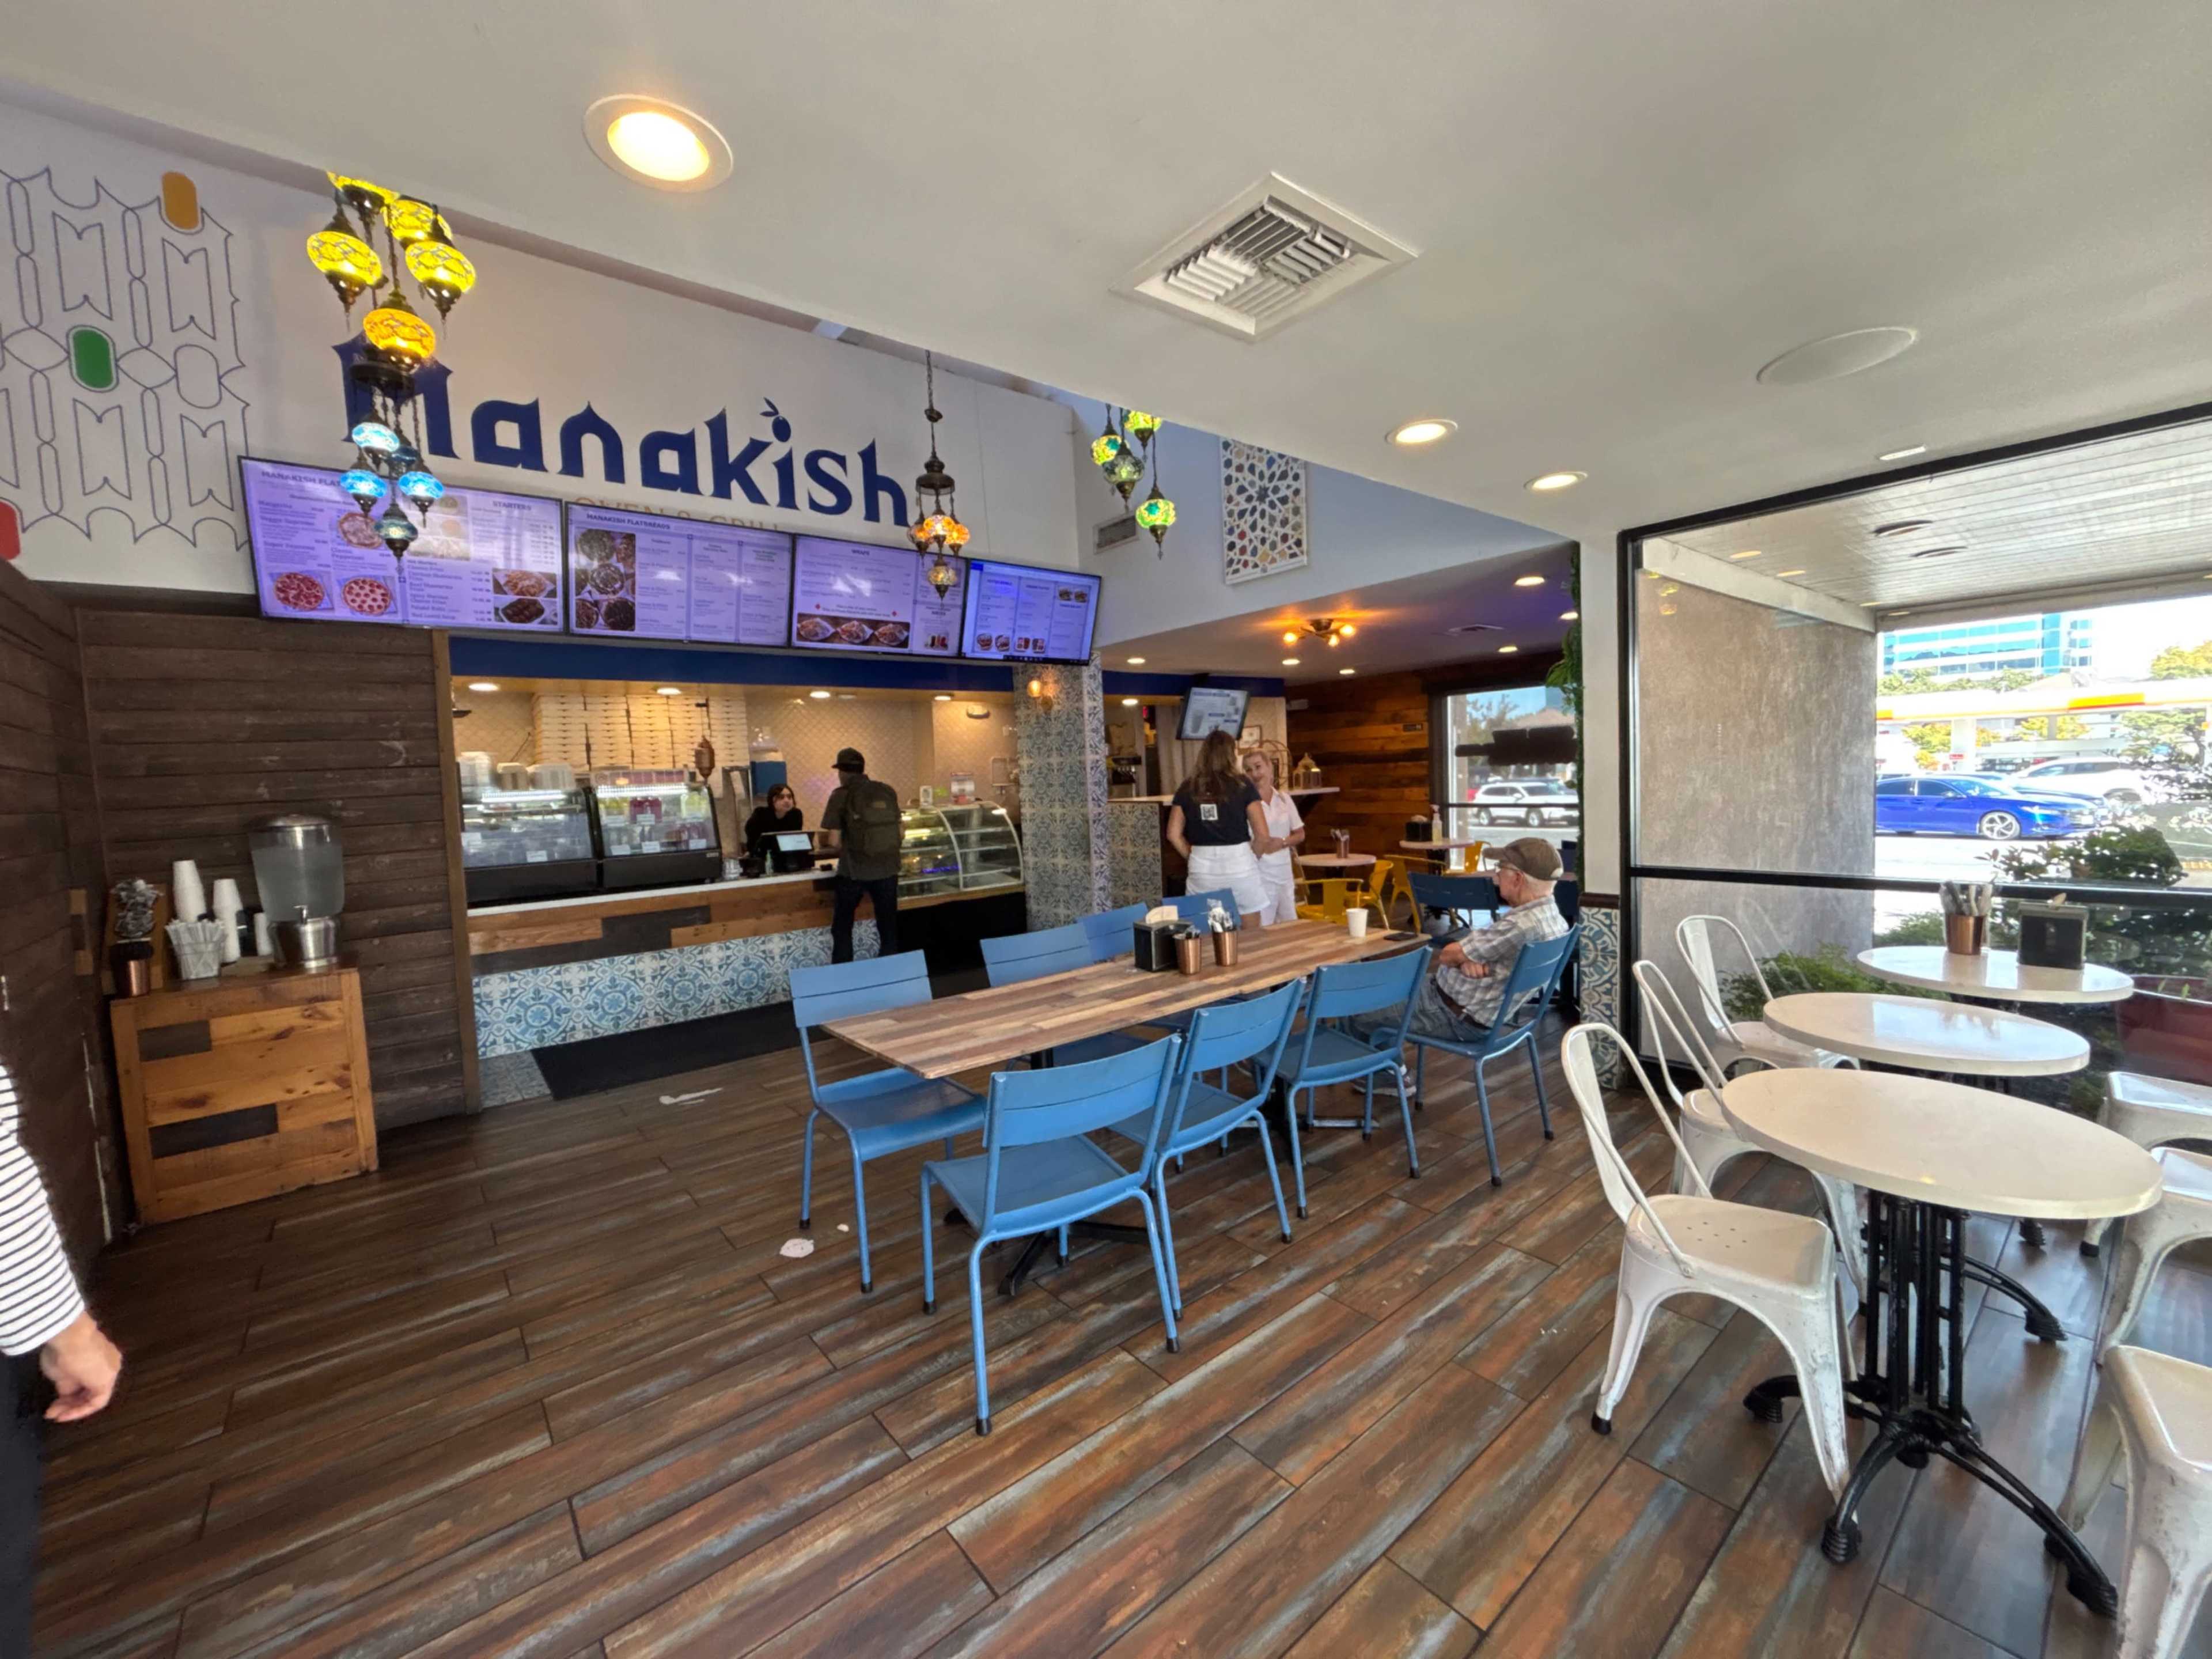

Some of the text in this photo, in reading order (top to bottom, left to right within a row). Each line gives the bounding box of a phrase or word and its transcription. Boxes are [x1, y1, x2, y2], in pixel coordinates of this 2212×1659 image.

[262, 471, 316, 483] MANAKISH
[493, 501, 532, 511] STARTERS
[586, 513, 626, 524] MANAKISH
